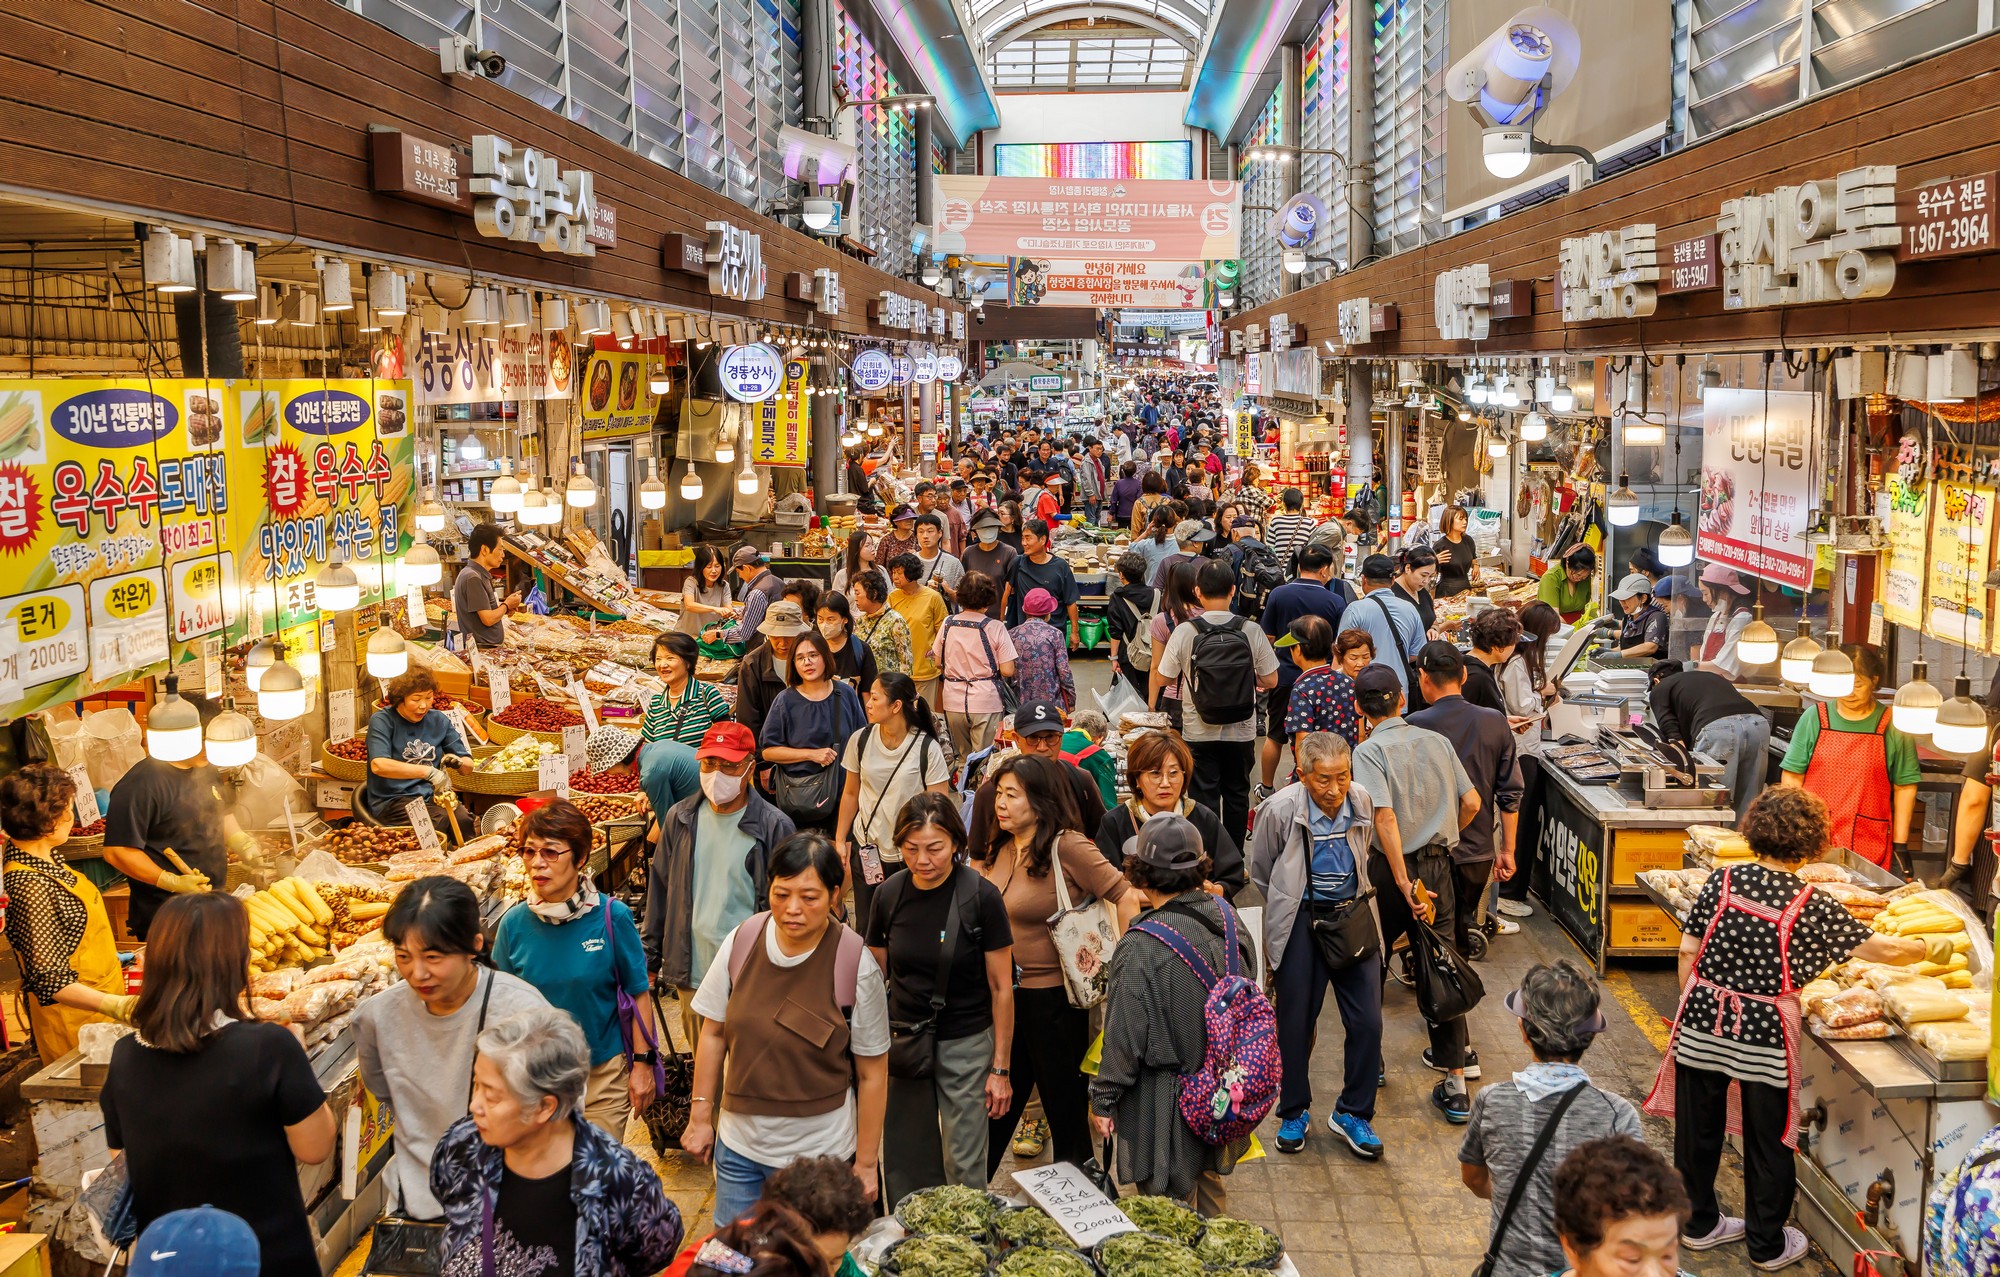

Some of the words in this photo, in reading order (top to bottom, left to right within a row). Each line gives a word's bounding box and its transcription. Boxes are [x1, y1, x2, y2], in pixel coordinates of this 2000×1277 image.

[1917, 185, 1956, 219] 옥수수
[1959, 178, 1987, 212] 전문
[1909, 213, 1989, 256] T.967-3964
[1673, 243, 1692, 264] 농산물
[1048, 276, 1075, 289] 청량리
[1122, 279, 1149, 291] 방문해
[1150, 279, 1176, 291] 주셔서
[1084, 262, 1115, 276] 안녕히
[1116, 263, 1147, 275] 가세요
[1090, 293, 1135, 305] 감사합니다.
[727, 365, 774, 380] 경동상사
[789, 365, 801, 377] 냉
[68, 404, 108, 435] 30년
[109, 401, 166, 434] 전통맛집
[294, 402, 320, 425] 30년
[321, 400, 361, 424] 전통맛집
[271, 453, 299, 506] 찰
[312, 440, 392, 508] 옥수수
[260, 513, 327, 581] 맛있게
[381, 504, 399, 555] 집
[112, 580, 152, 613] 작은거
[20, 601, 57, 636] 큰거
[0, 652, 19, 681] 개
[29, 640, 79, 671] 2000원
[1035, 705, 1047, 720] S
